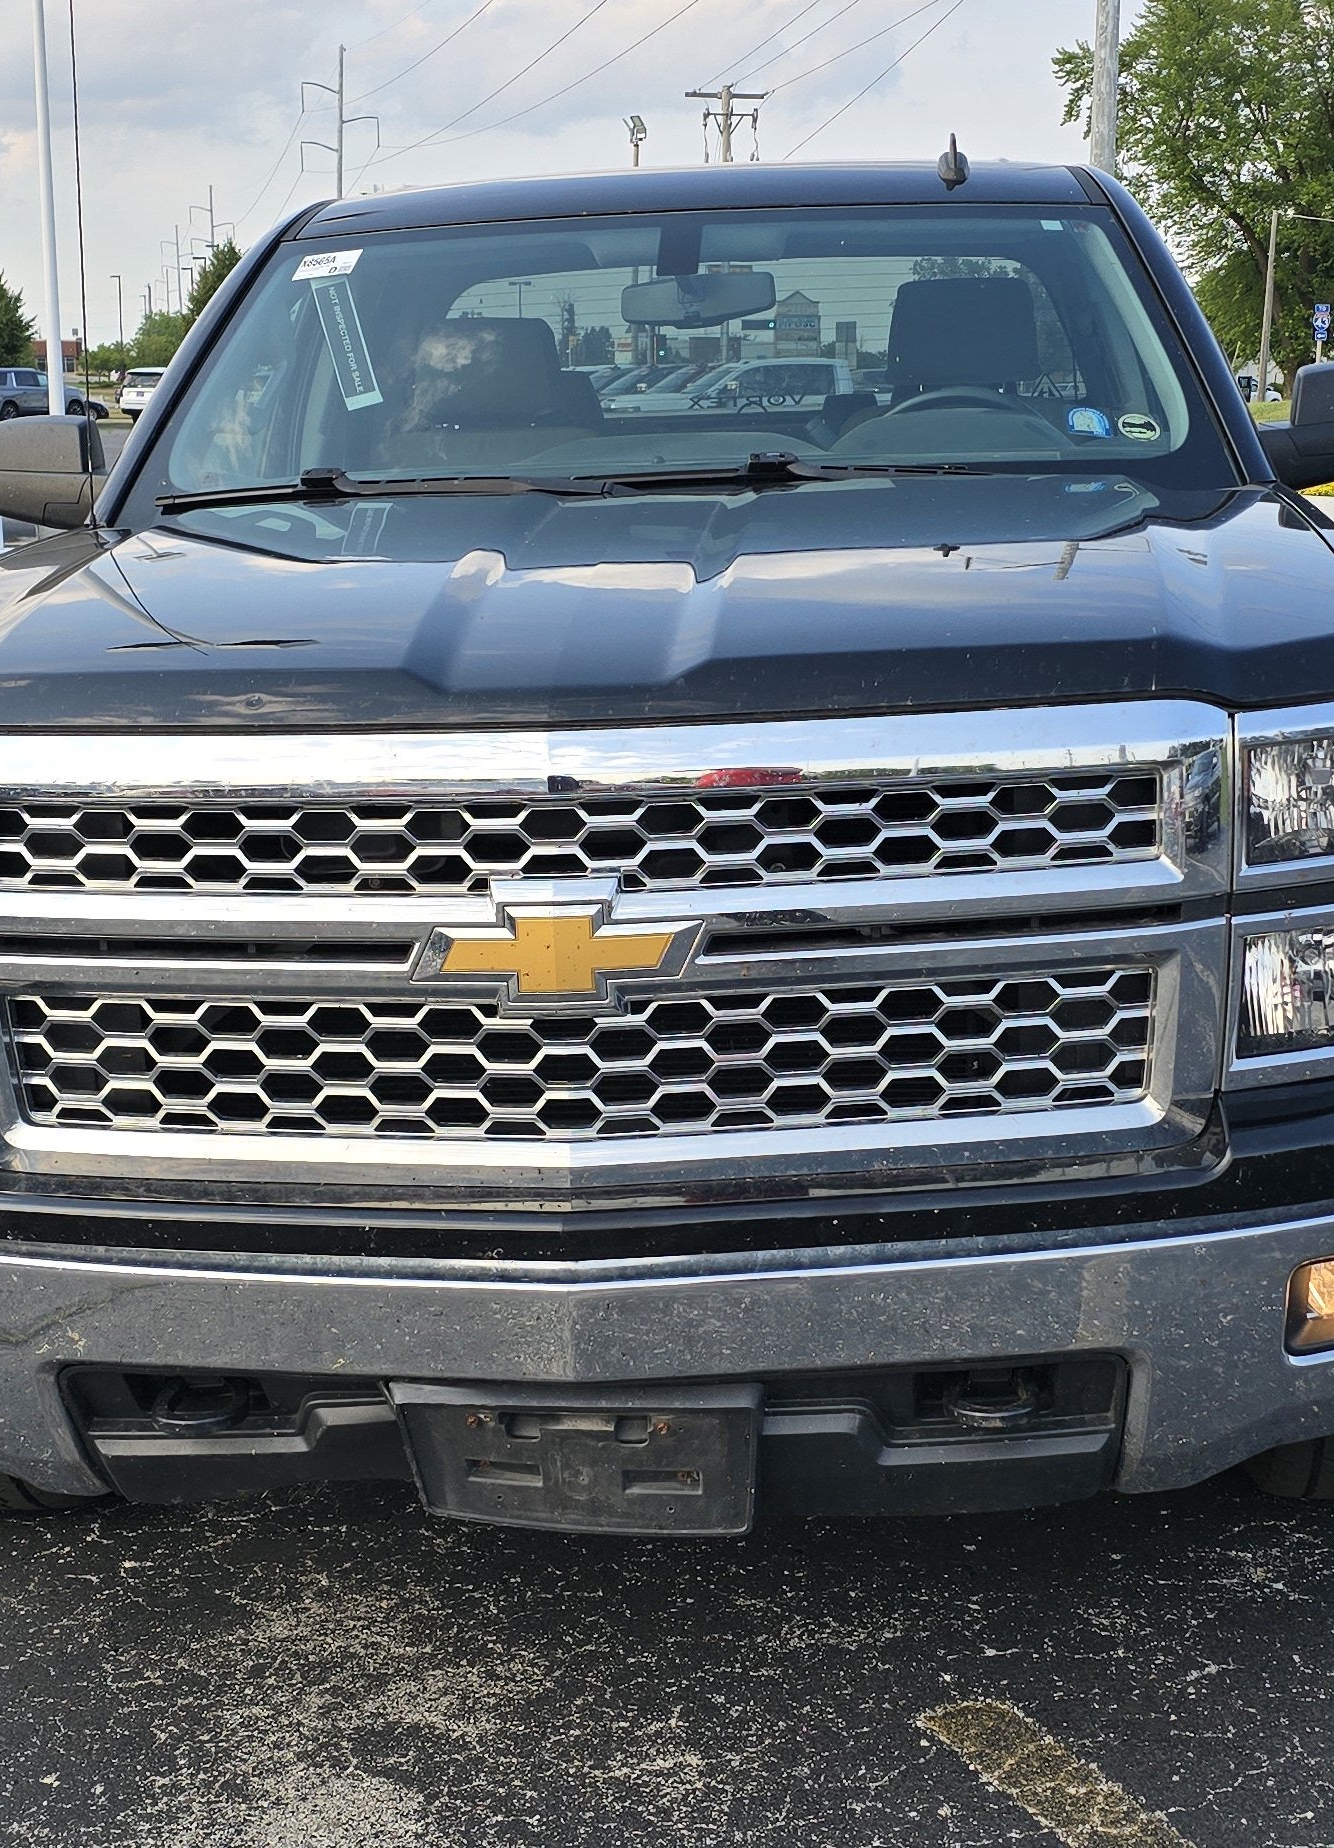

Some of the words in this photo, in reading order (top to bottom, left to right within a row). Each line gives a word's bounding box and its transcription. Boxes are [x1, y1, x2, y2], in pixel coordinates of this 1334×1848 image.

[328, 286, 340, 305] NOT
[333, 305, 352, 352] INSPECTED
[346, 352, 358, 371] FOR
[351, 371, 364, 393] SALE
